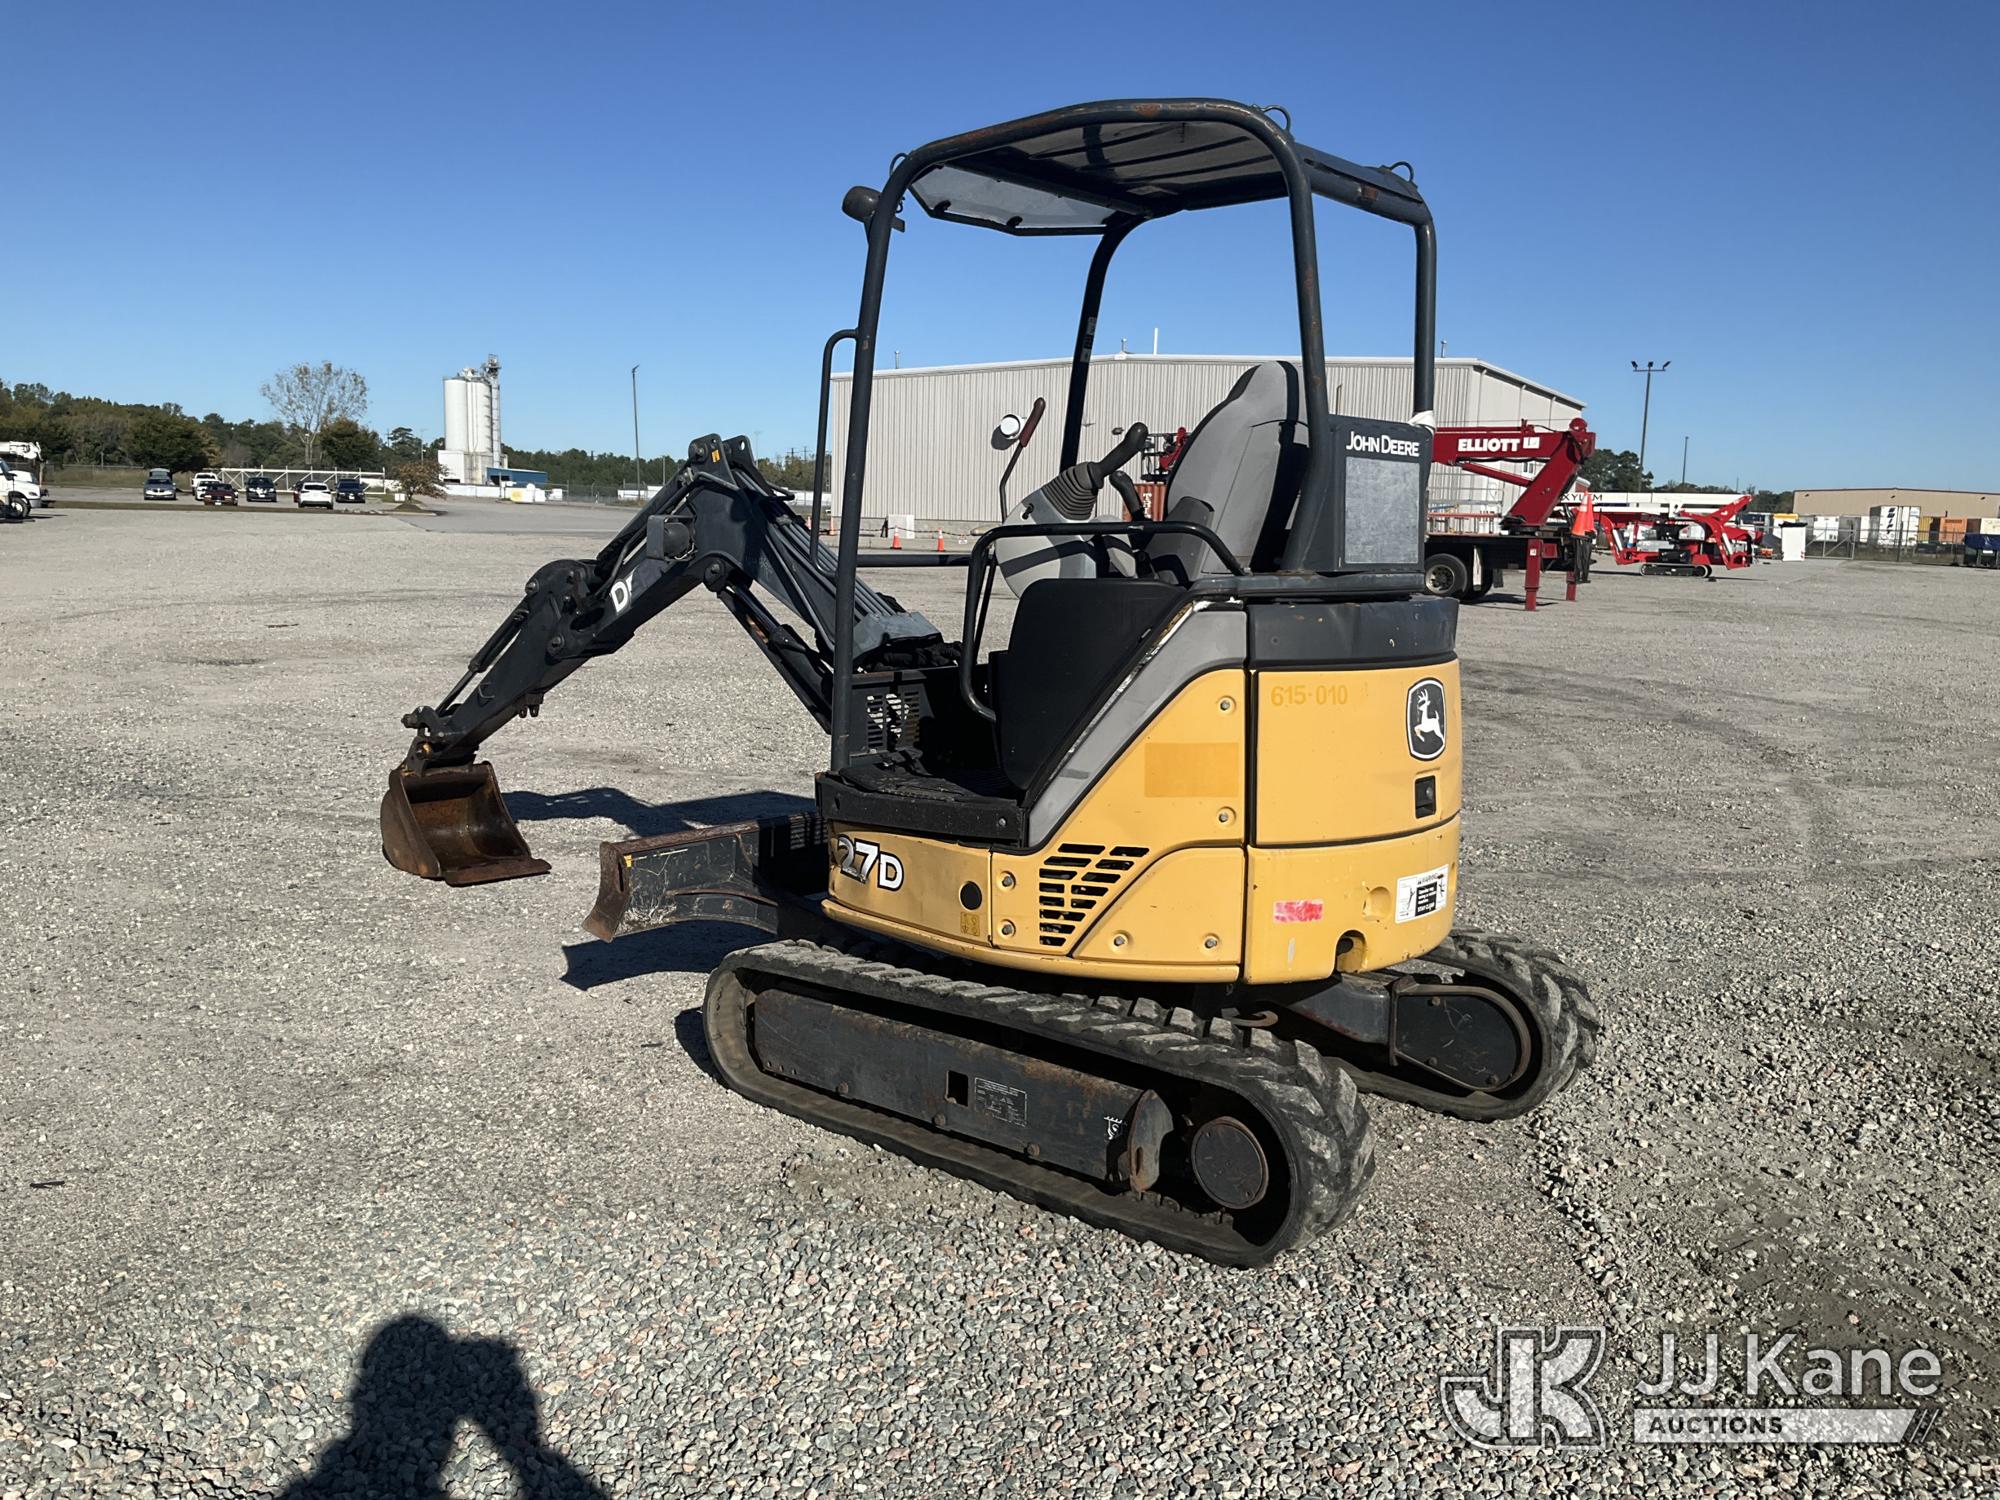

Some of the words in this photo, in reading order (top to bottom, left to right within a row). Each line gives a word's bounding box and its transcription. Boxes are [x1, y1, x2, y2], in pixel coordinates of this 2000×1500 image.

[1345, 430, 1380, 453] JOHN
[1381, 434, 1420, 457] DEERE
[1457, 438, 1520, 453] ELLIOTT
[1561, 493, 1603, 502] XYLM
[1270, 684, 1348, 707] 615-010
[837, 833, 904, 892] 27D
